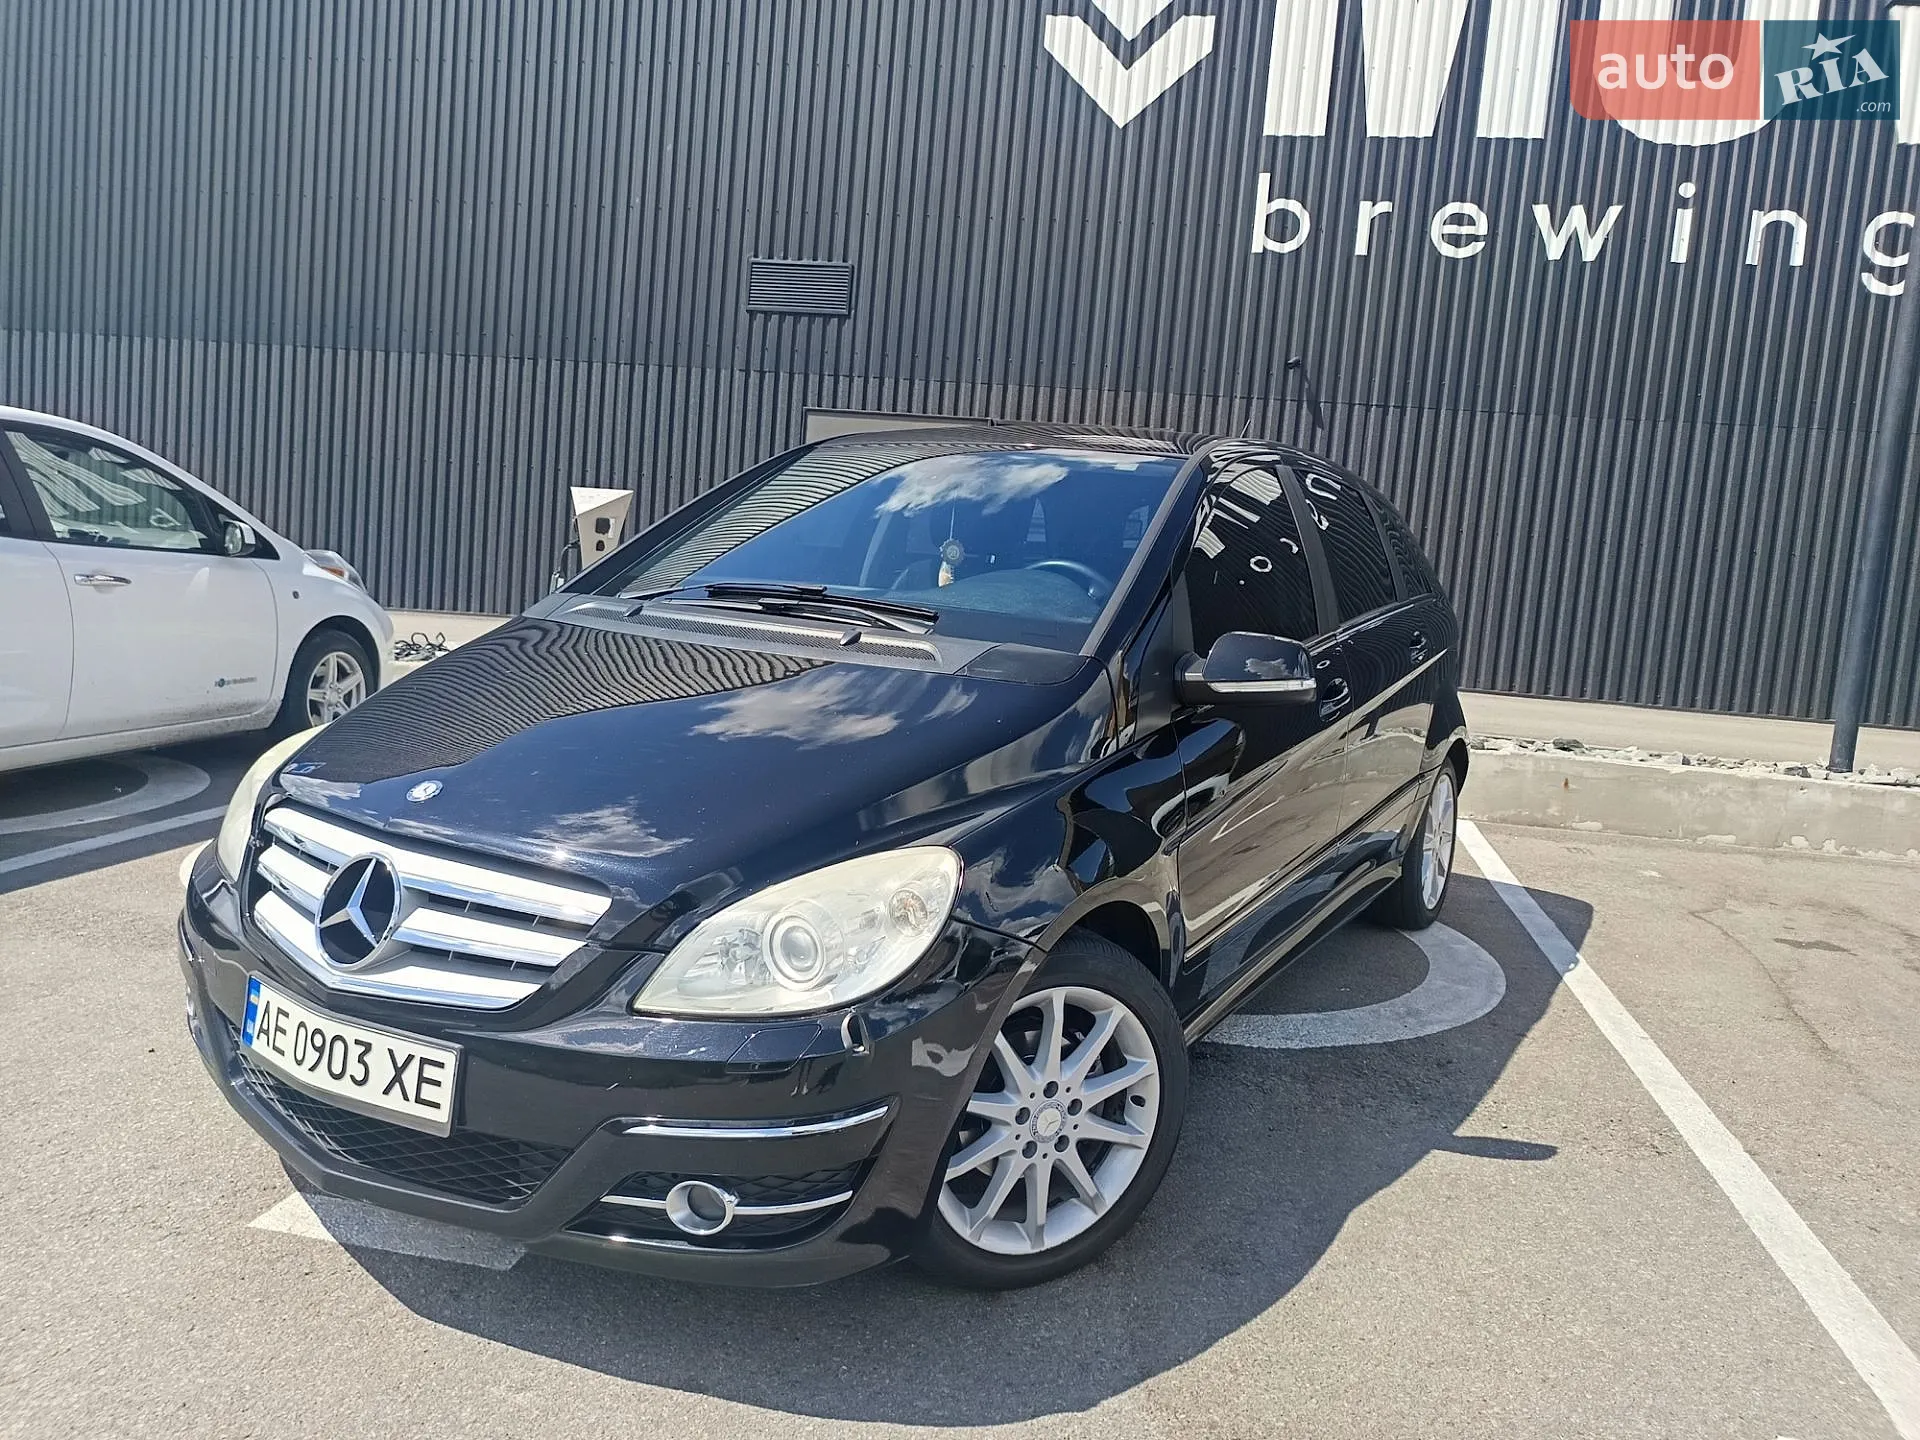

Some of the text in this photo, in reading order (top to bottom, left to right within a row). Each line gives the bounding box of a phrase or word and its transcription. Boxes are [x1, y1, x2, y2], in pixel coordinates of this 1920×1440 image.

[1251, 172, 1916, 297] brewing
[256, 1000, 446, 1110] AE 0903 XE
